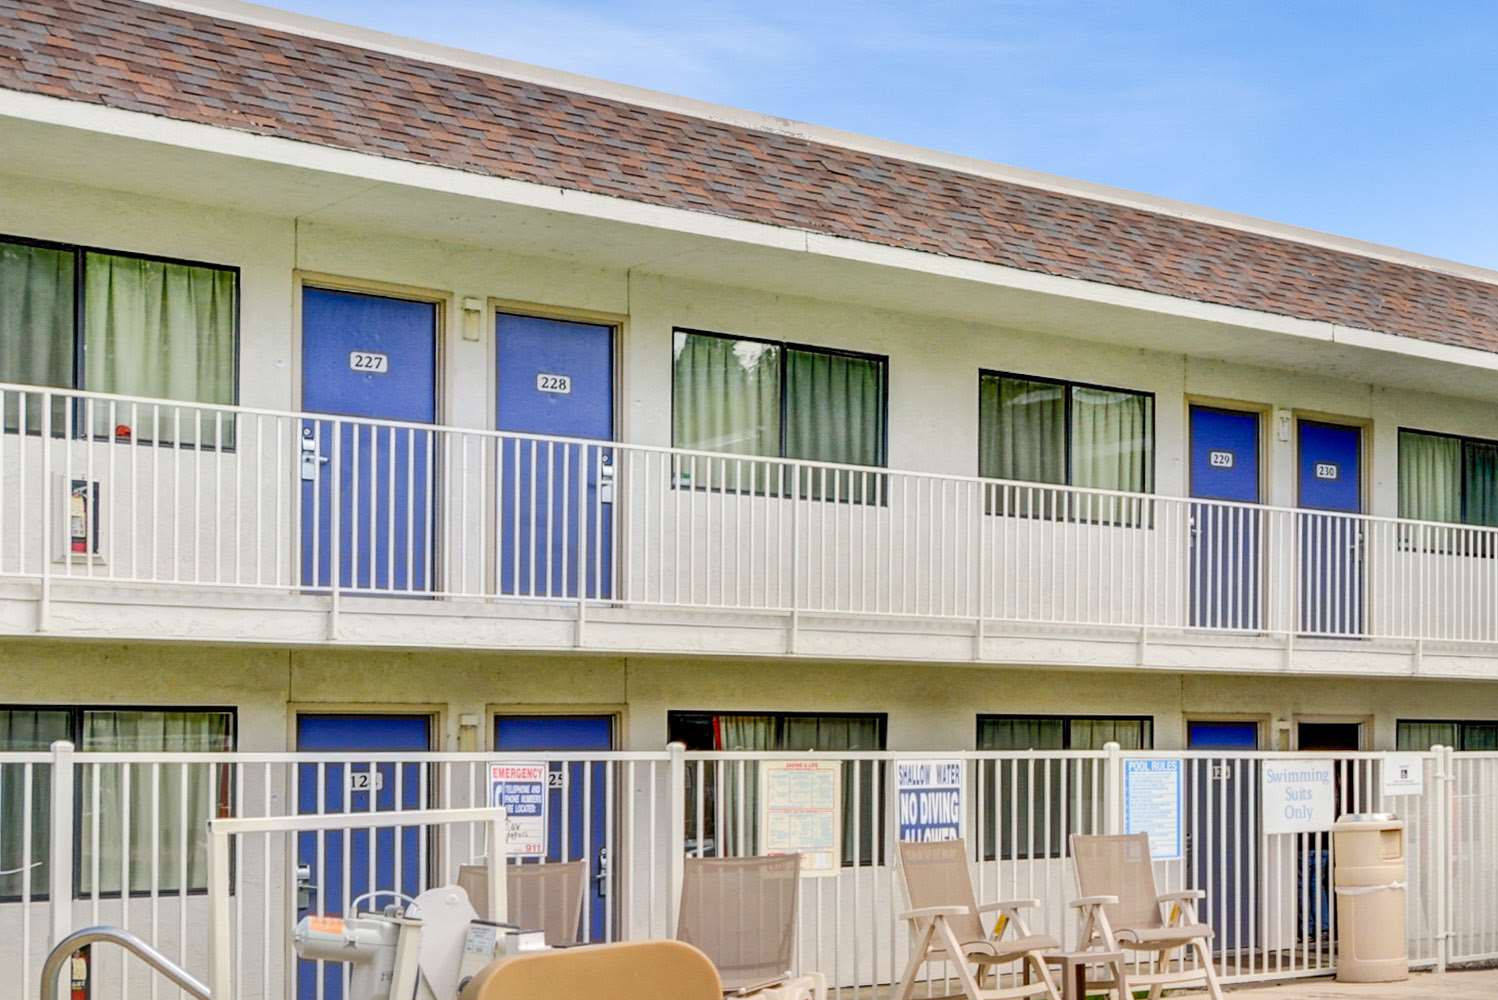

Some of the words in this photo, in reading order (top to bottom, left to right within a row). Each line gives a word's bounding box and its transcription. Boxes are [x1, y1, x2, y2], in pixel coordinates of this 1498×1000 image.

[354, 354, 383, 370] 227
[541, 376, 567, 391] 228
[1213, 454, 1230, 465] 229
[1318, 465, 1335, 477] 230
[492, 767, 544, 779] EMERGENCY
[899, 764, 930, 785] SHALLOW
[936, 763, 960, 785] WATER
[1128, 760, 1151, 772] POOL
[1152, 760, 1178, 772] RULES
[1266, 768, 1329, 785] Swimming
[1284, 786, 1313, 802] Suits
[900, 792, 918, 825] NO
[920, 791, 960, 824] DIVING
[1284, 804, 1313, 822] Only
